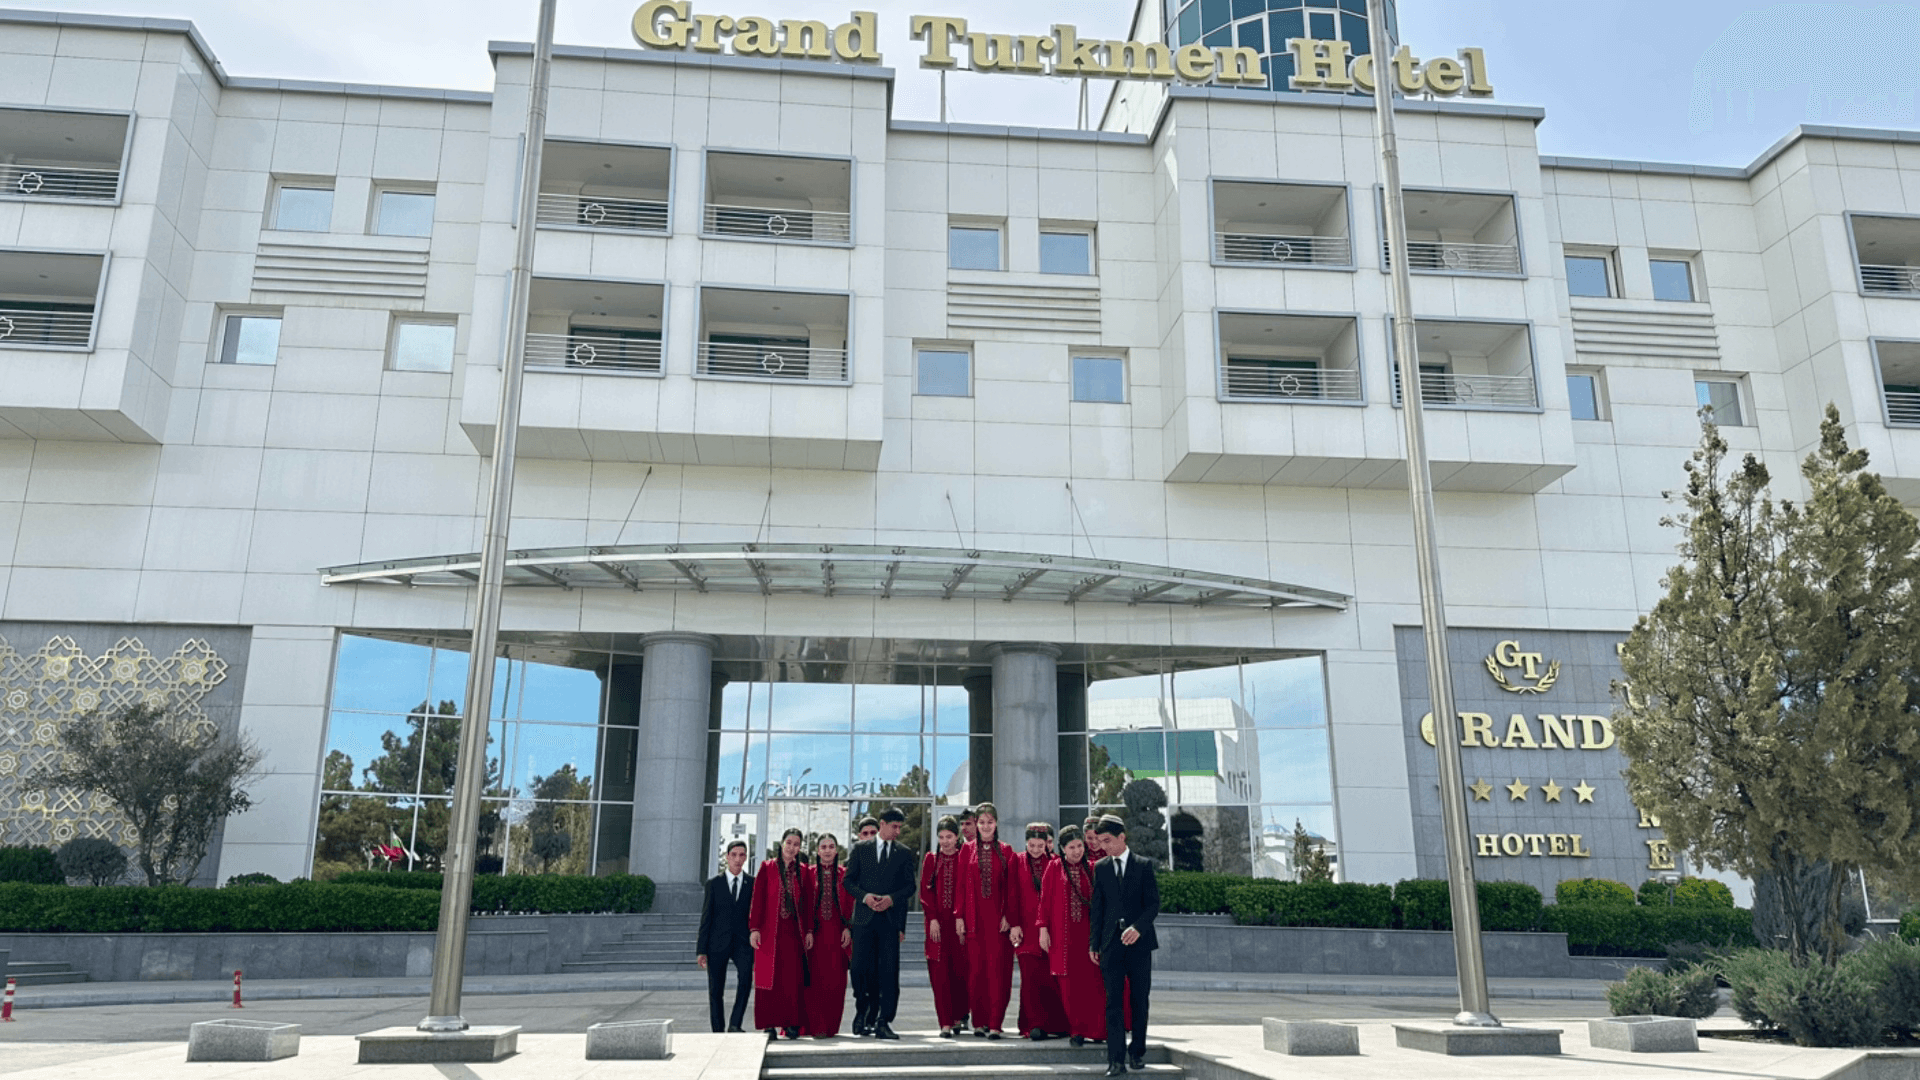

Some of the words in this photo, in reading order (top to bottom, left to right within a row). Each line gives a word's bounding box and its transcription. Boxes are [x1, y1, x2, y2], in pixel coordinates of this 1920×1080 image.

[632, 0, 881, 64] Grand
[910, 14, 1267, 86] Turkmen
[1476, 833, 1591, 858] HOTEL
